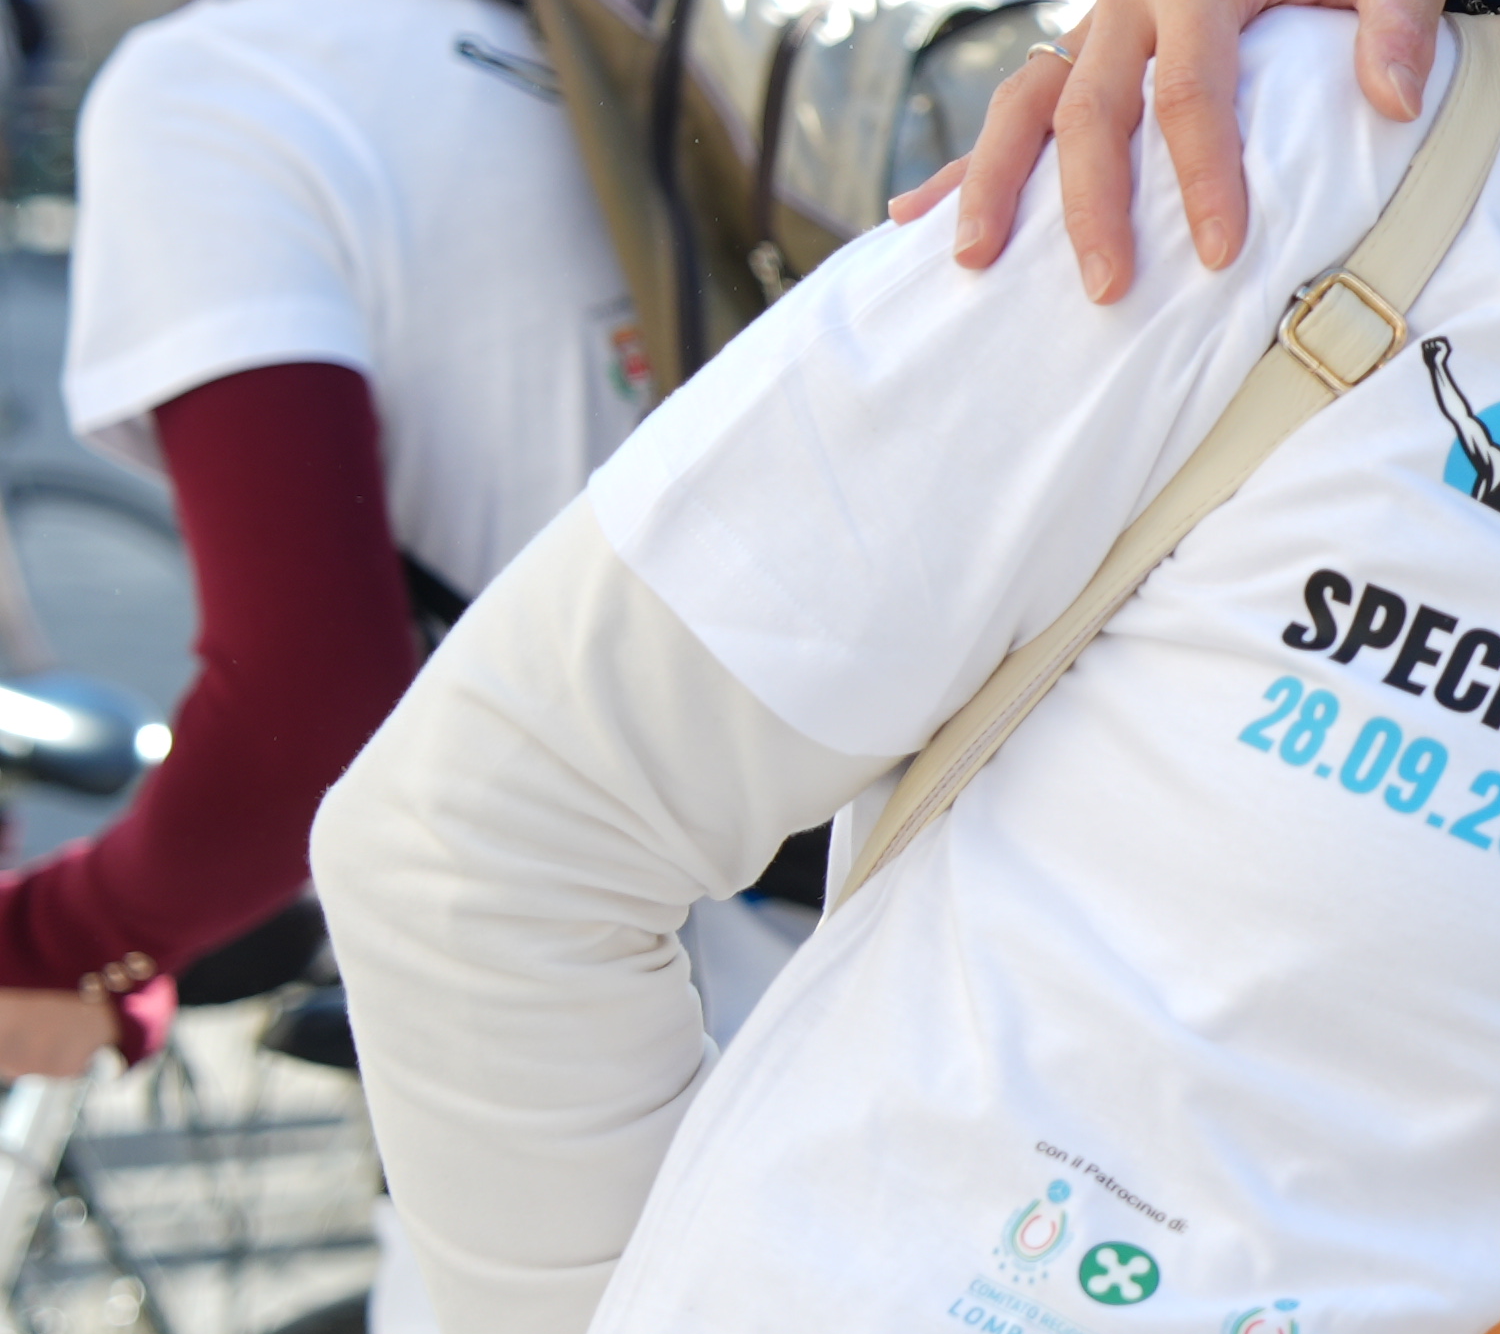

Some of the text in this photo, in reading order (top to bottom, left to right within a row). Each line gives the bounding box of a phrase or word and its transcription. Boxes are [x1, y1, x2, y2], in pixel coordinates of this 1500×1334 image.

[1034, 1139, 1069, 1163] con
[1071, 1153, 1084, 1170] il
[1083, 1162, 1168, 1224] Patrocinio
